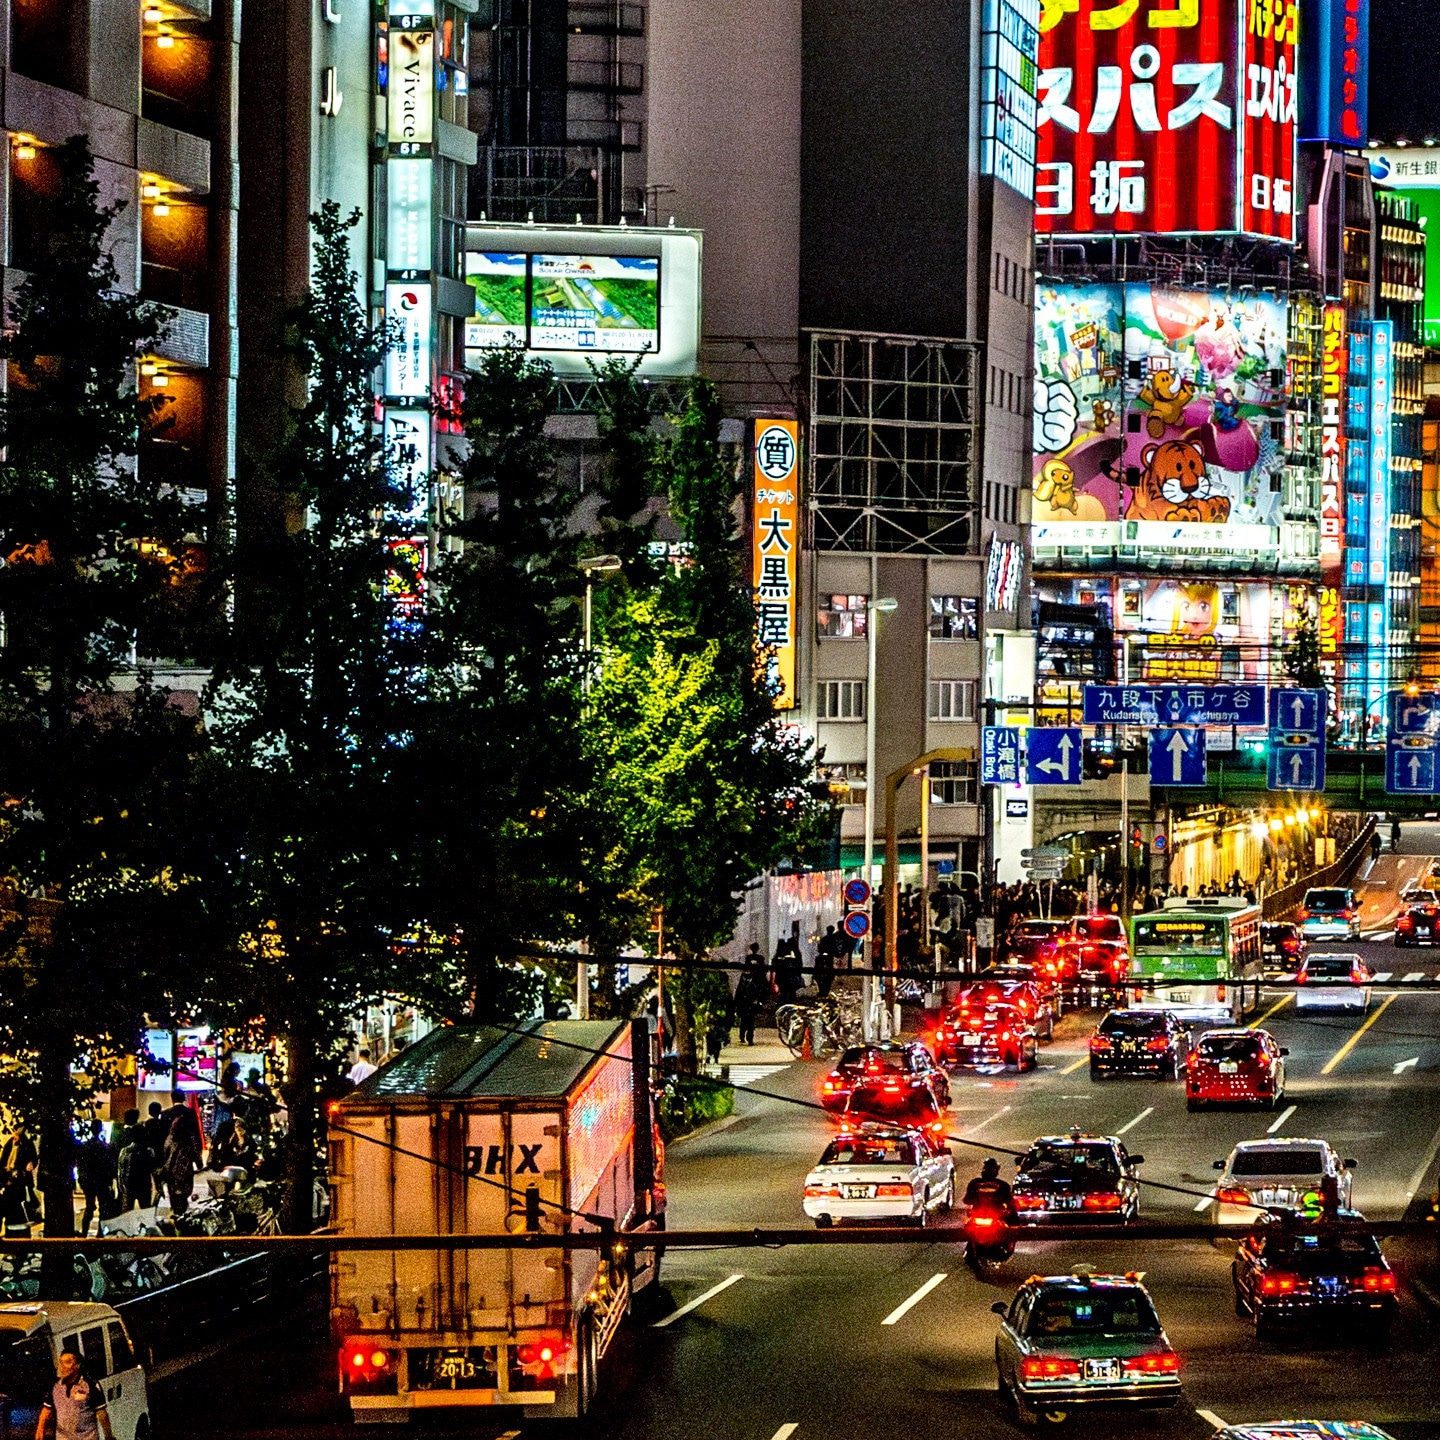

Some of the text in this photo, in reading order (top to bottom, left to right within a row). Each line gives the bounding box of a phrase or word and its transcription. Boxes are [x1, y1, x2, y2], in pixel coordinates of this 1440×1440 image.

[402, 16, 421, 27] 6F
[402, 60, 420, 138] Vivace
[1246, 54, 1297, 127] エスパス
[400, 143, 420, 155] 5F
[402, 271, 418, 280] 4F
[1324, 310, 1342, 394] パチンコ
[400, 396, 416, 406] 3F
[764, 435, 791, 472] 質
[1321, 398, 1340, 519] エスパス
[757, 488, 794, 505] チケット
[757, 508, 792, 649] 大黒屋
[1319, 587, 1338, 654] パチンコ
[1097, 690, 1164, 709] 九段下
[984, 730, 996, 781] Otaki Brdg.
[997, 730, 1017, 781] 小滝橋
[440, 1363, 475, 1378] 20-13
